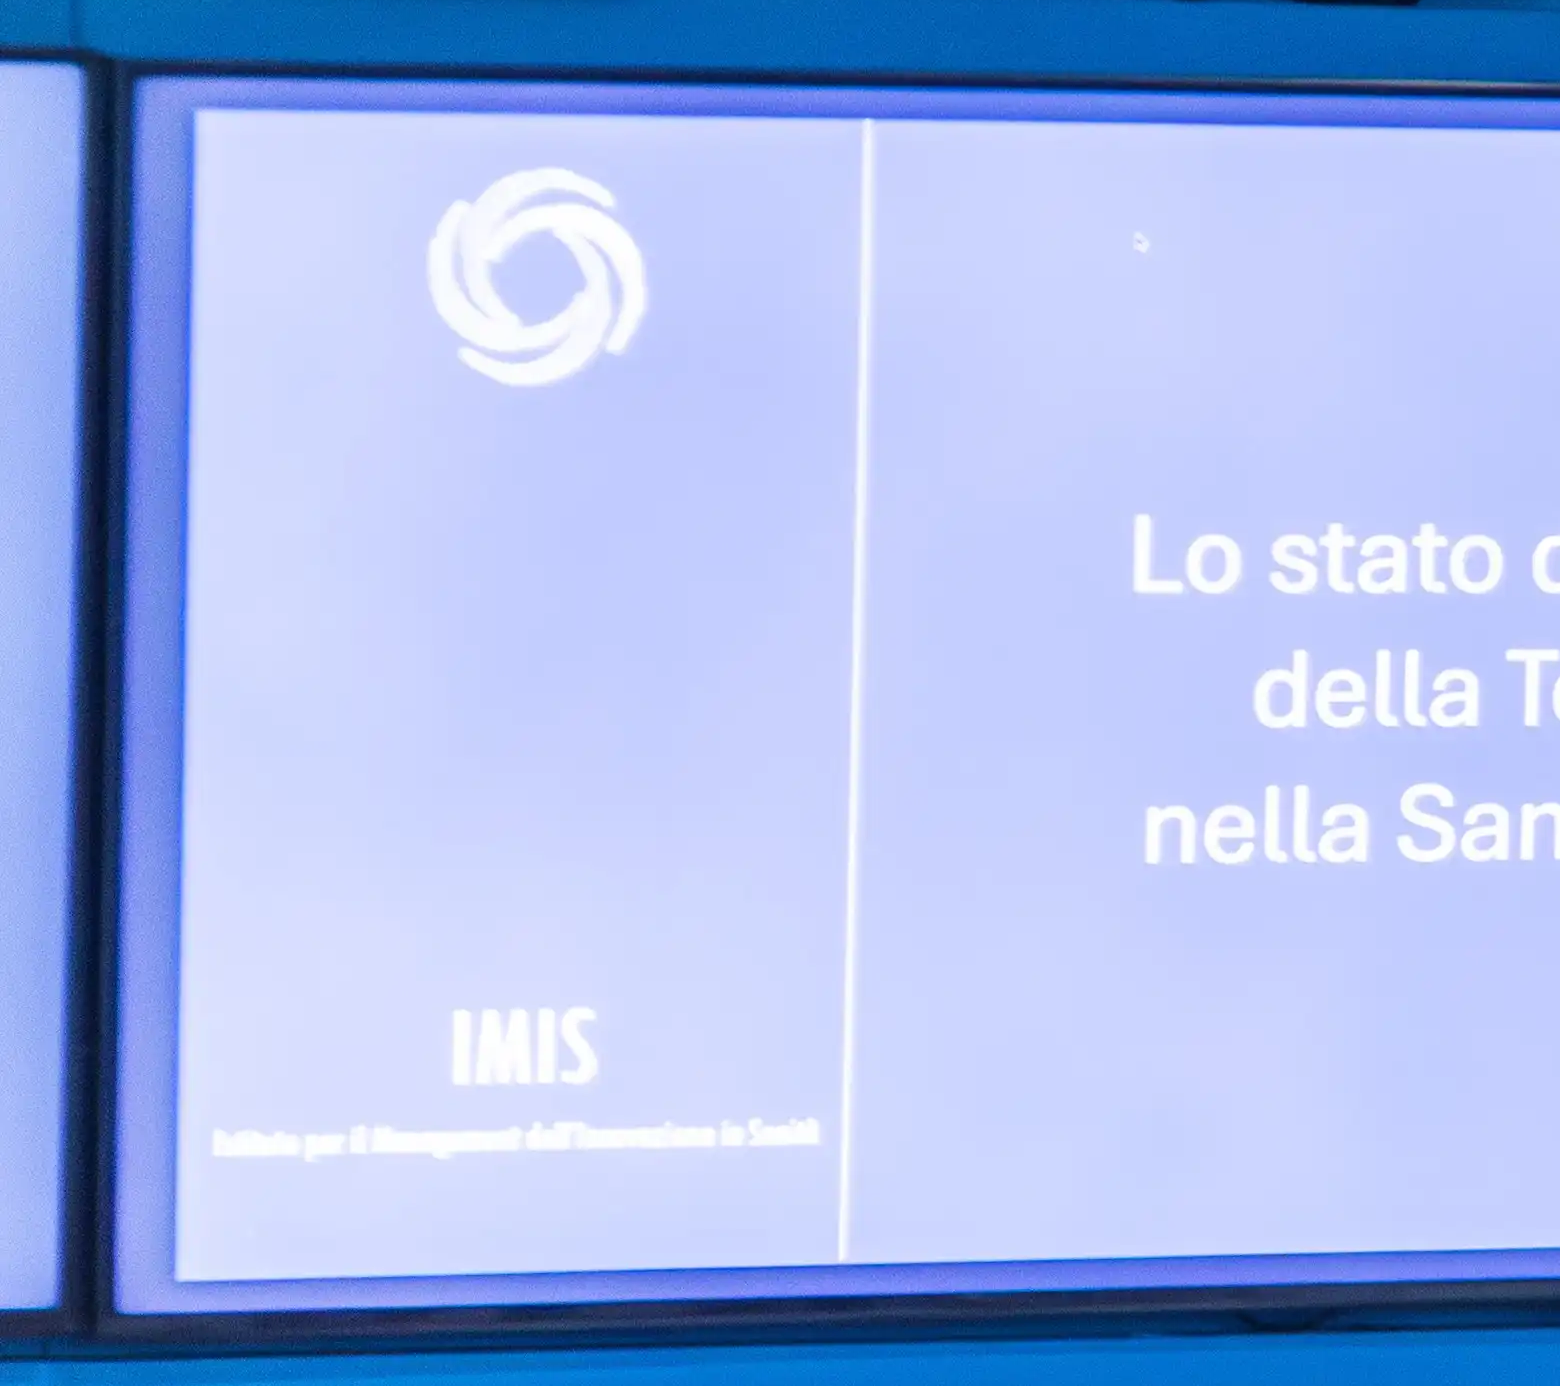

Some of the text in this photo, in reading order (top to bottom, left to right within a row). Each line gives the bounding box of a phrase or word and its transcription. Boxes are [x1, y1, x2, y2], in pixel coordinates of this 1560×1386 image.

[1133, 514, 1242, 594] Lo
[1270, 523, 1504, 594] stato
[1254, 649, 1479, 729] della
[1145, 784, 1369, 865] nella
[451, 1006, 598, 1086] IMIS
